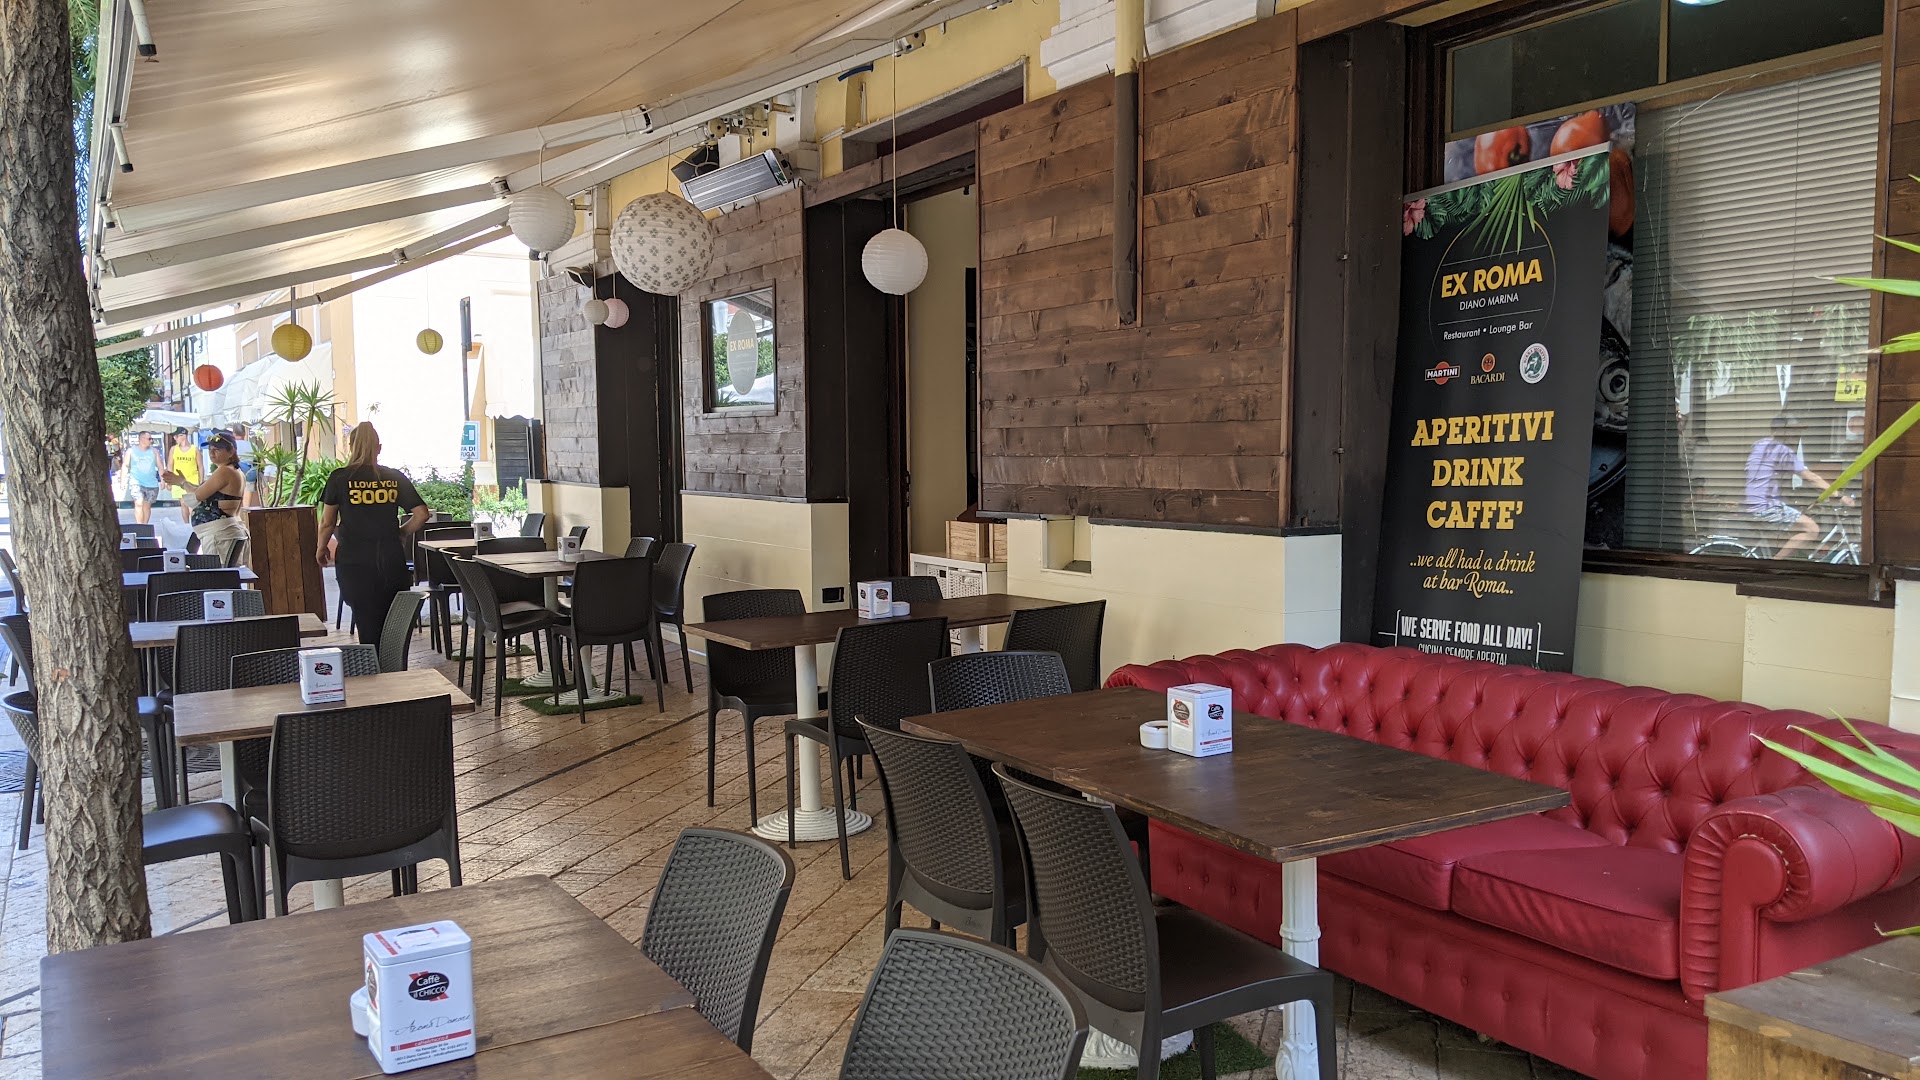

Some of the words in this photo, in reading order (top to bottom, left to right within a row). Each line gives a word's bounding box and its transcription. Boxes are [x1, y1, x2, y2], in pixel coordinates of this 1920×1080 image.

[1441, 272, 1469, 298] EX
[1473, 258, 1543, 293] ROMA
[1460, 298, 1486, 310] DIANO
[1488, 293, 1519, 306] MARINA
[1444, 328, 1480, 340] Restaurant
[1490, 324, 1516, 334] Lounge
[1519, 321, 1533, 330] Bar
[730, 341, 736, 351] EX
[738, 338, 754, 350] ROMA
[1427, 368, 1458, 378] MARTINI
[1470, 372, 1505, 384] BACARDI
[1411, 411, 1554, 446] APERITIVI
[1432, 457, 1524, 486] DRINK
[380, 480, 397, 488] YOU
[349, 489, 398, 504] 3000
[1427, 501, 1523, 529] CAFFE'
[1436, 548, 1458, 568] all
[1457, 549, 1484, 570] had
[1484, 558, 1493, 570] a
[1496, 550, 1535, 572] drink
[1423, 575, 1438, 588] at
[1439, 570, 1463, 590] bar
[1464, 571, 1513, 598] Roma..
[1402, 616, 1418, 637] WE
[1420, 618, 1452, 641] SERVE
[1454, 621, 1480, 644] FOOD
[1482, 624, 1502, 647] ALL
[1506, 626, 1533, 650] DAY!
[416, 975, 440, 986] Caffè
[419, 986, 446, 997] CHICCO
